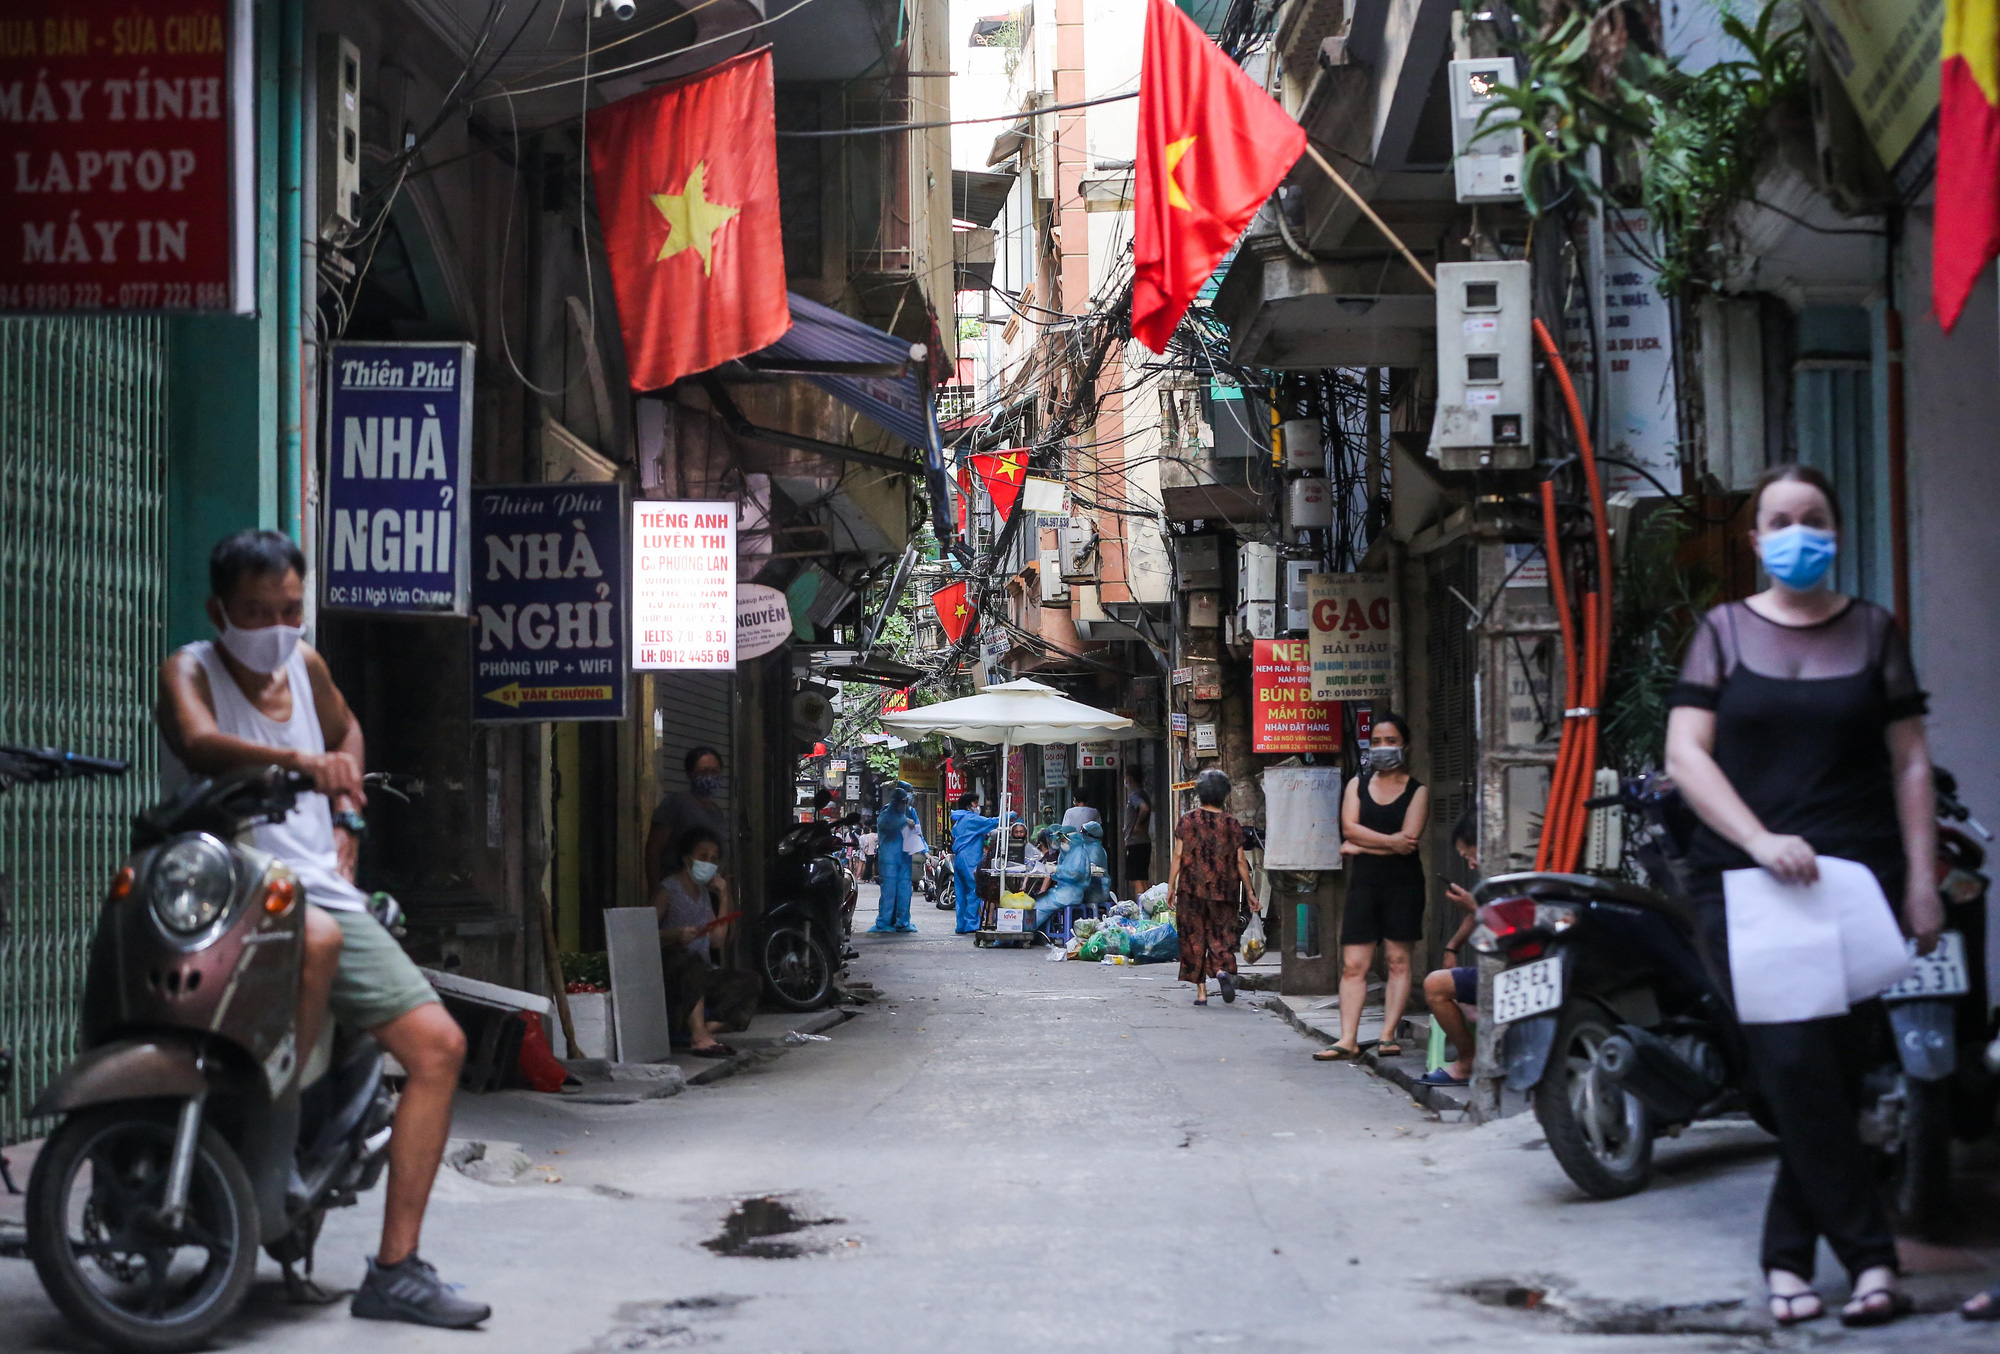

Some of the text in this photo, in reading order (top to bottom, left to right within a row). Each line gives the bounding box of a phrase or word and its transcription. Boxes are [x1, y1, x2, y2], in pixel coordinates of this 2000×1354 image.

[0, 18, 36, 55] UA
[0, 66, 220, 121] MÁY TÍNH
[15, 149, 196, 192] LAPTOP
[22, 210, 188, 263] MÁY IN
[341, 358, 455, 387] Thiên Phú
[343, 404, 447, 480] NHÀ
[481, 493, 602, 516] Thiên Phú
[641, 508, 728, 528] TIẾNG ANH
[333, 486, 453, 573] NGHỈ
[485, 518, 603, 581] NHÀ
[701, 535, 725, 549] THI
[707, 556, 728, 571] LAN
[330, 587, 348, 602] ĐC:
[351, 587, 363, 602] 51
[759, 593, 775, 602] Artist
[477, 582, 614, 651] NGHỈ
[1312, 597, 1390, 640] GẠO
[644, 630, 673, 643] IELTS
[705, 630, 727, 644] 8.5)
[641, 649, 730, 663] LH: 0912 4455 69
[1322, 641, 1388, 655] HẢI HẬU
[480, 658, 613, 677] PHÒNG VIP + WIFI
[1275, 664, 1290, 672] RÁN
[1297, 676, 1311, 684] ĐỊN
[502, 686, 604, 701] 51 VĂN CHƯƠNG
[1260, 685, 1295, 702] BÚN
[1268, 704, 1327, 719] MẮM TÔM
[1265, 722, 1330, 732] NHẬN ĐẶT HÀNG
